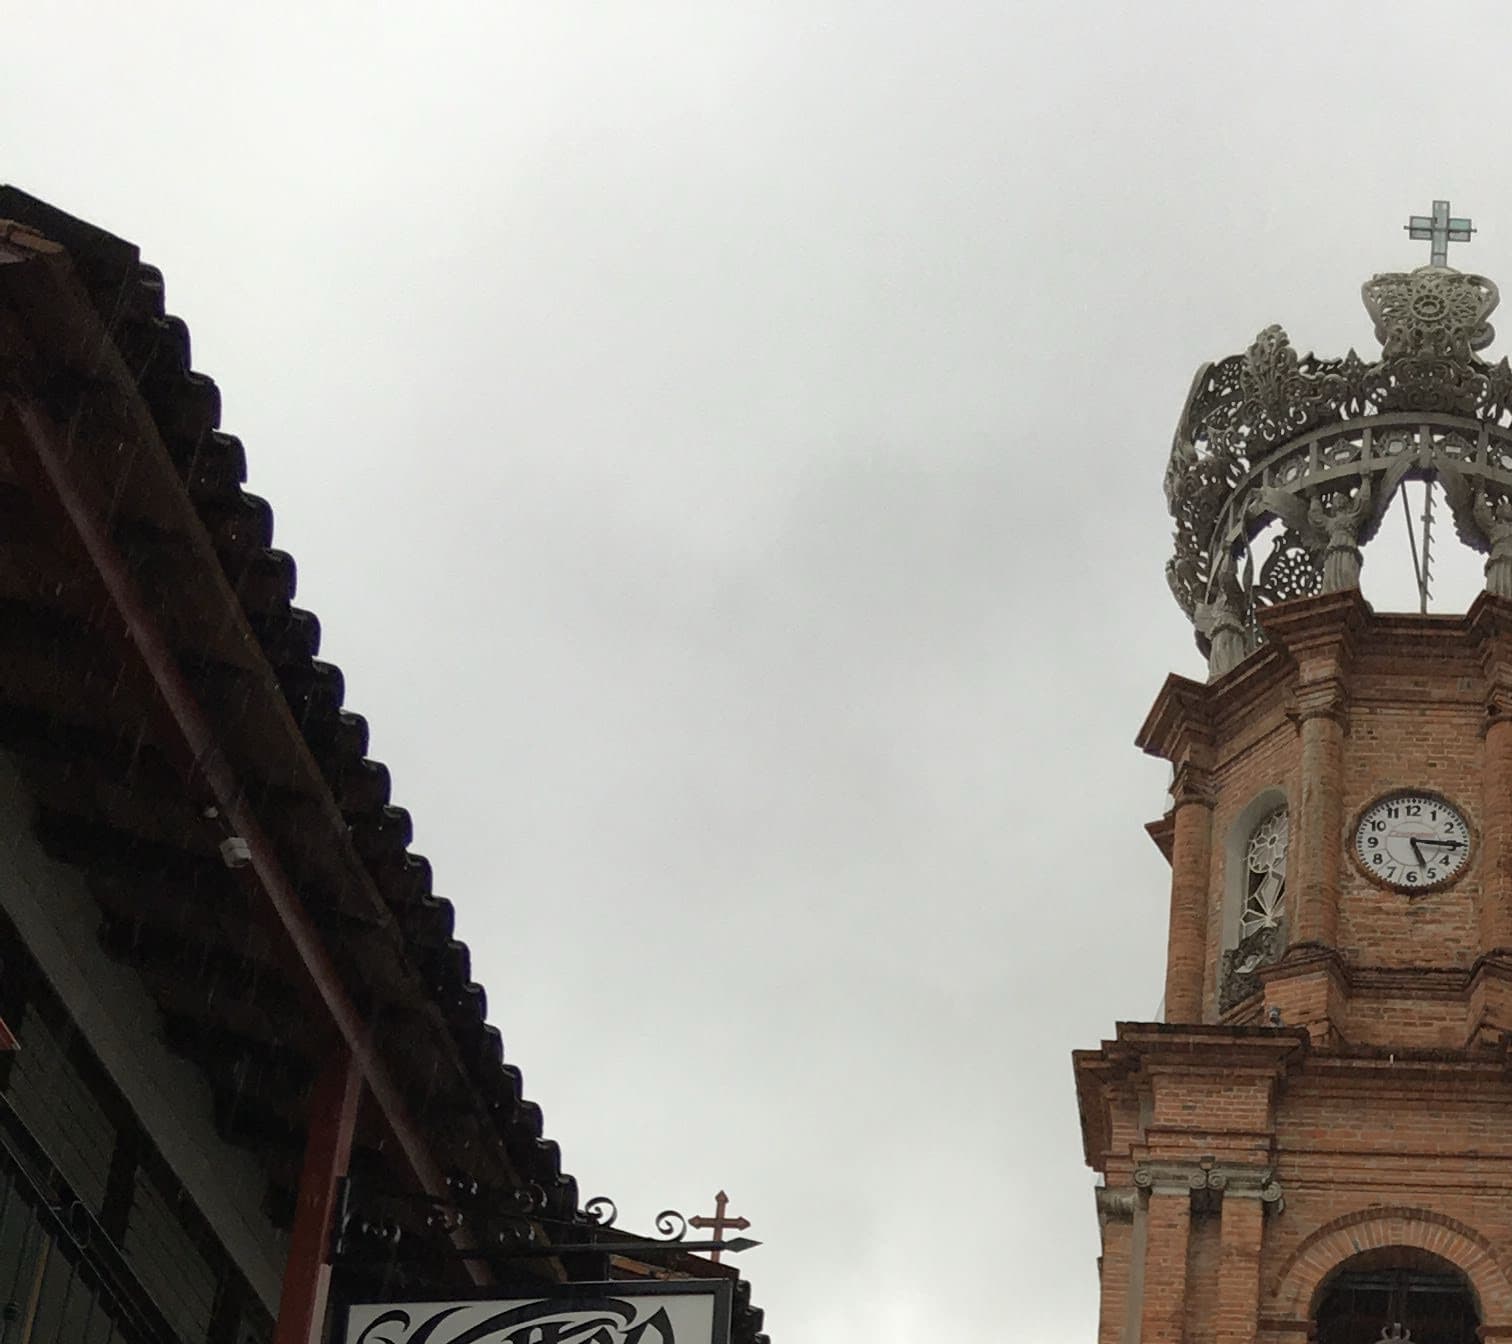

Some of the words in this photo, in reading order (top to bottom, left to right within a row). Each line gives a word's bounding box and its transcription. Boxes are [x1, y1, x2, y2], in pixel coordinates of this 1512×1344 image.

[1387, 807, 1400, 819] 11
[1405, 804, 1422, 817] 12
[1430, 810, 1437, 821] 1
[1369, 820, 1387, 832] 10
[1443, 821, 1455, 834] 2
[1367, 836, 1379, 848] 9
[1372, 853, 1384, 865] 8
[1438, 854, 1451, 866] 4
[1386, 866, 1397, 879] 7
[1405, 871, 1418, 883] 6
[1426, 867, 1438, 879] 5
